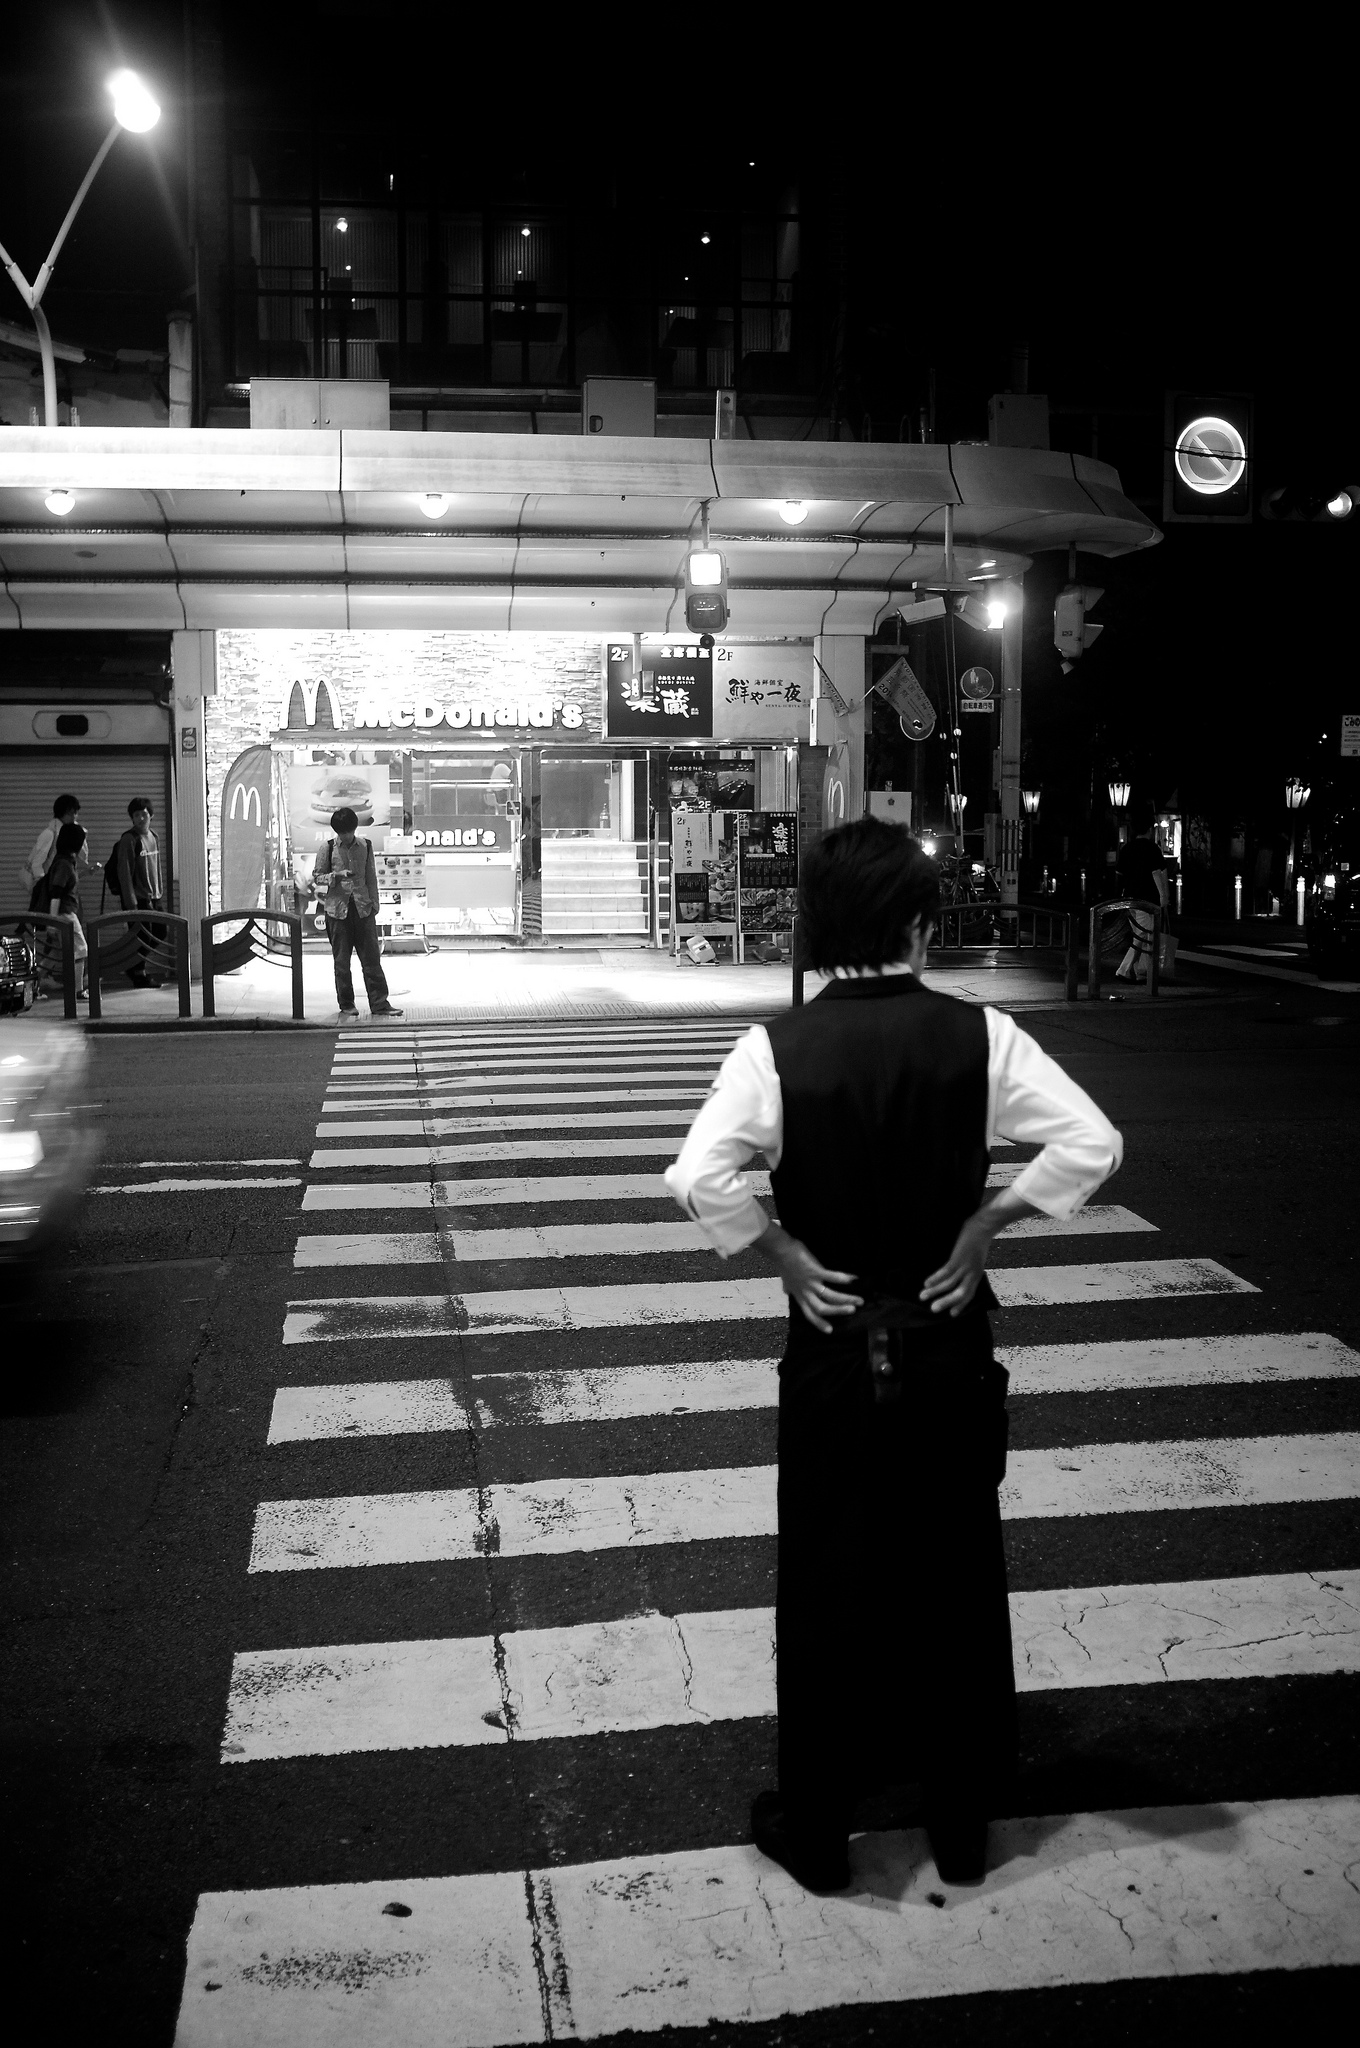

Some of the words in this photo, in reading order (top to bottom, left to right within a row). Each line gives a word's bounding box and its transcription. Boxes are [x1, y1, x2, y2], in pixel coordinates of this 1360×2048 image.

[611, 646, 629, 661] 2F
[717, 647, 734, 661] 2F
[725, 678, 802, 706] 鮮や一夜
[354, 700, 584, 729] McDonald's
